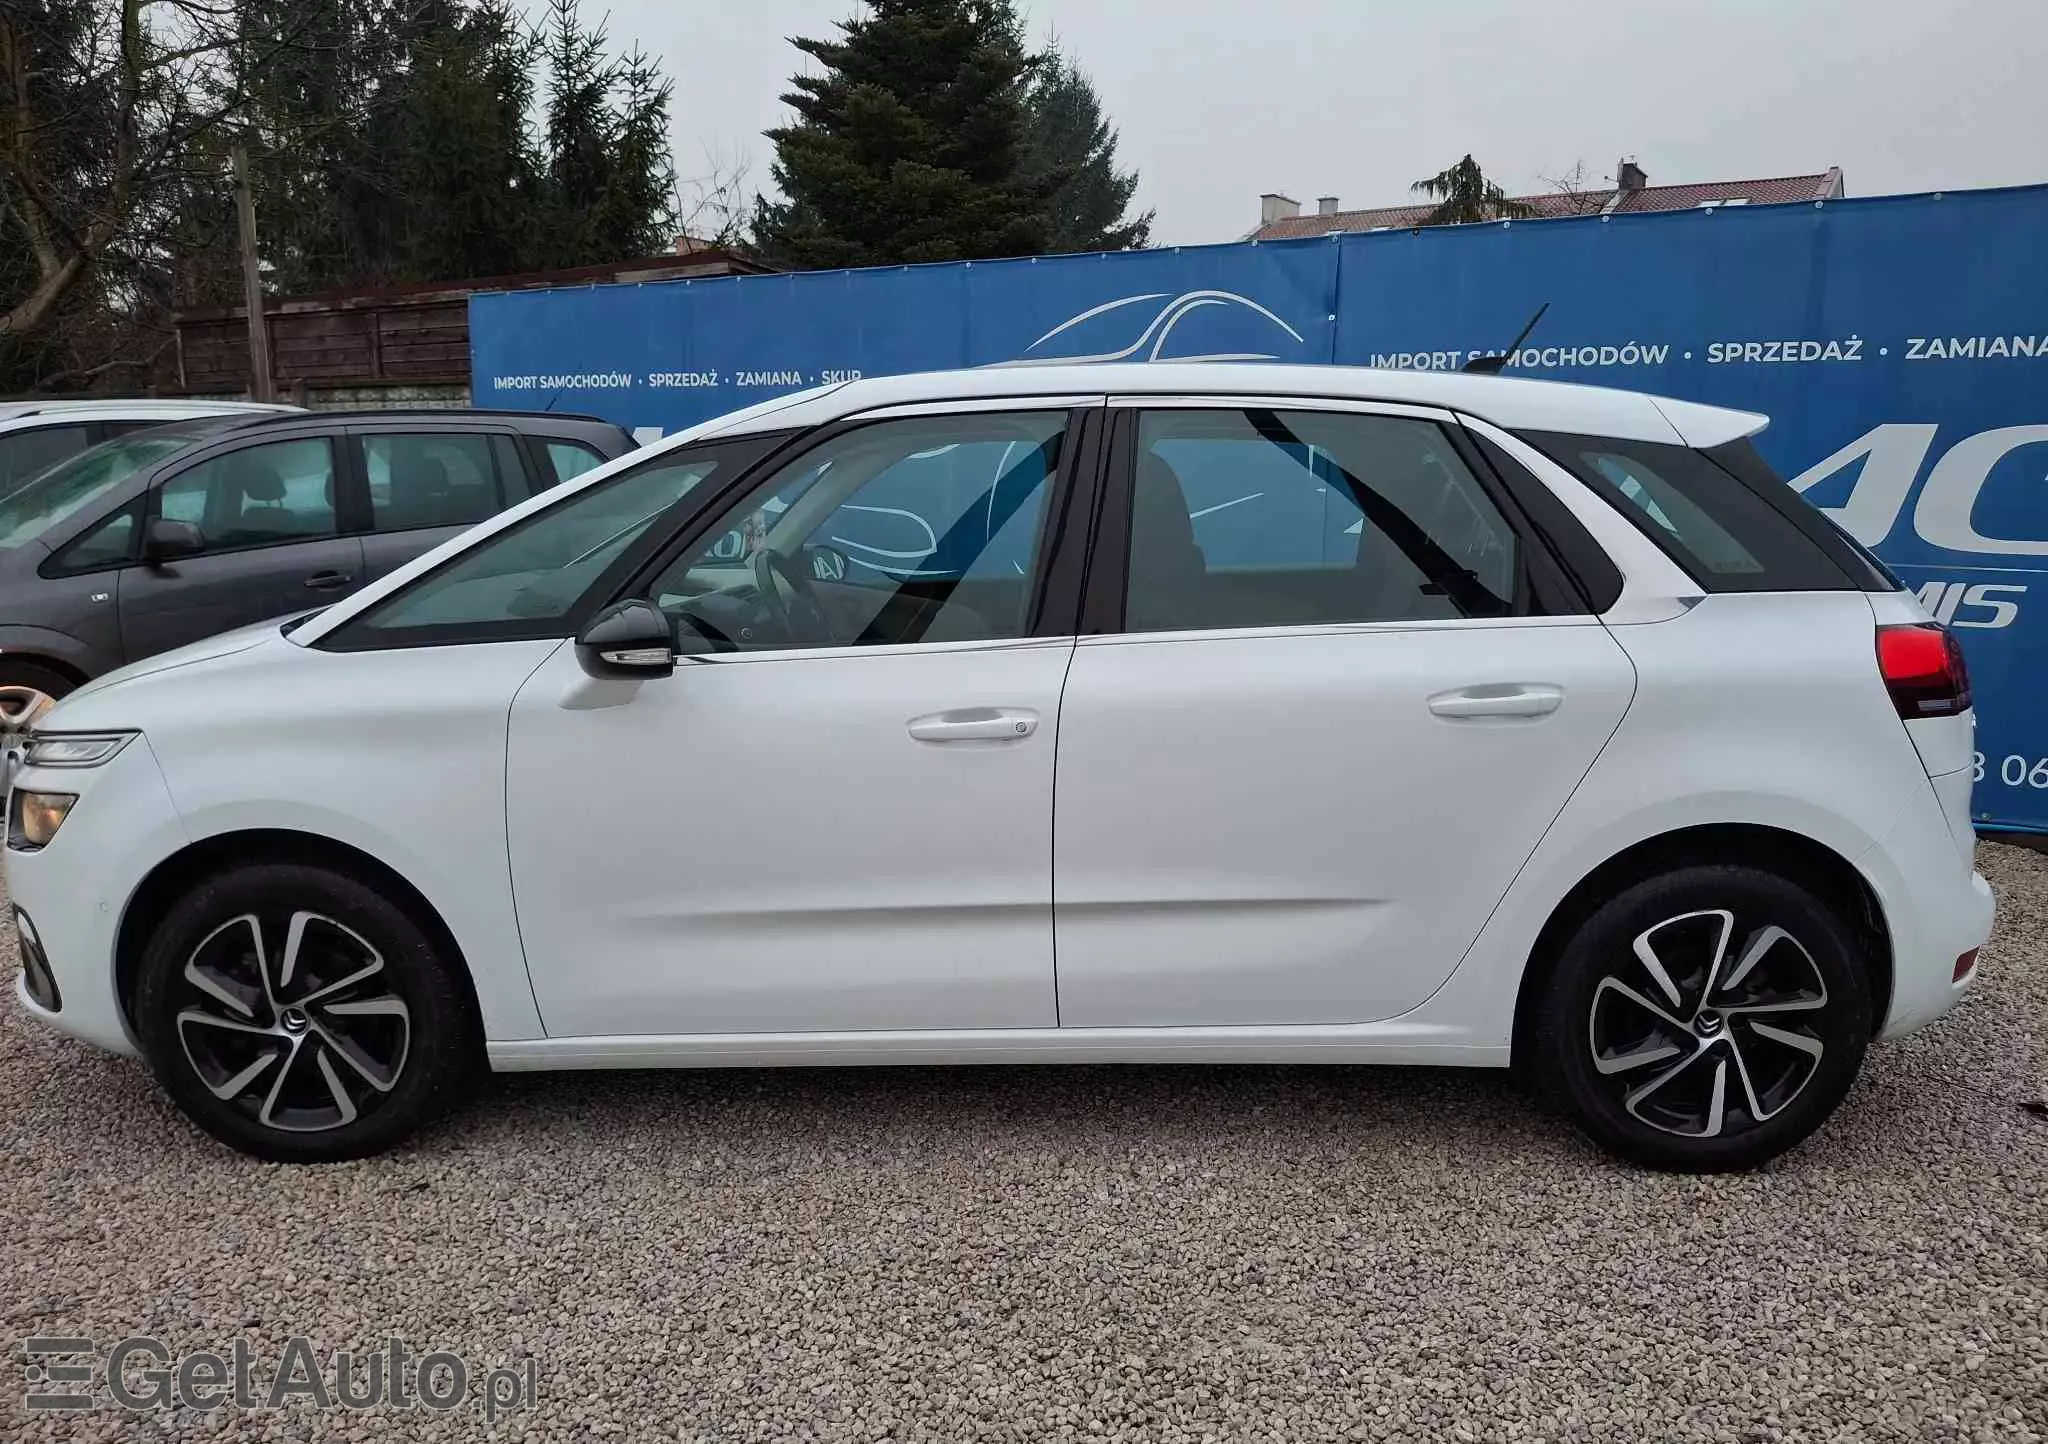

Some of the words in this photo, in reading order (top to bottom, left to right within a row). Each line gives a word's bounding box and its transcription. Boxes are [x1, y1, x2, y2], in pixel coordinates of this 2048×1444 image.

[1370, 351, 1461, 370] IMPORT
[1707, 334, 1863, 363] SPRZEDAŻ
[494, 376, 537, 390] IMPORT
[540, 371, 632, 388] SAMOCHODÓW
[648, 369, 718, 387] SPRZEDAŻ
[736, 371, 802, 387] ZAMIANA
[821, 369, 861, 385] SKUP
